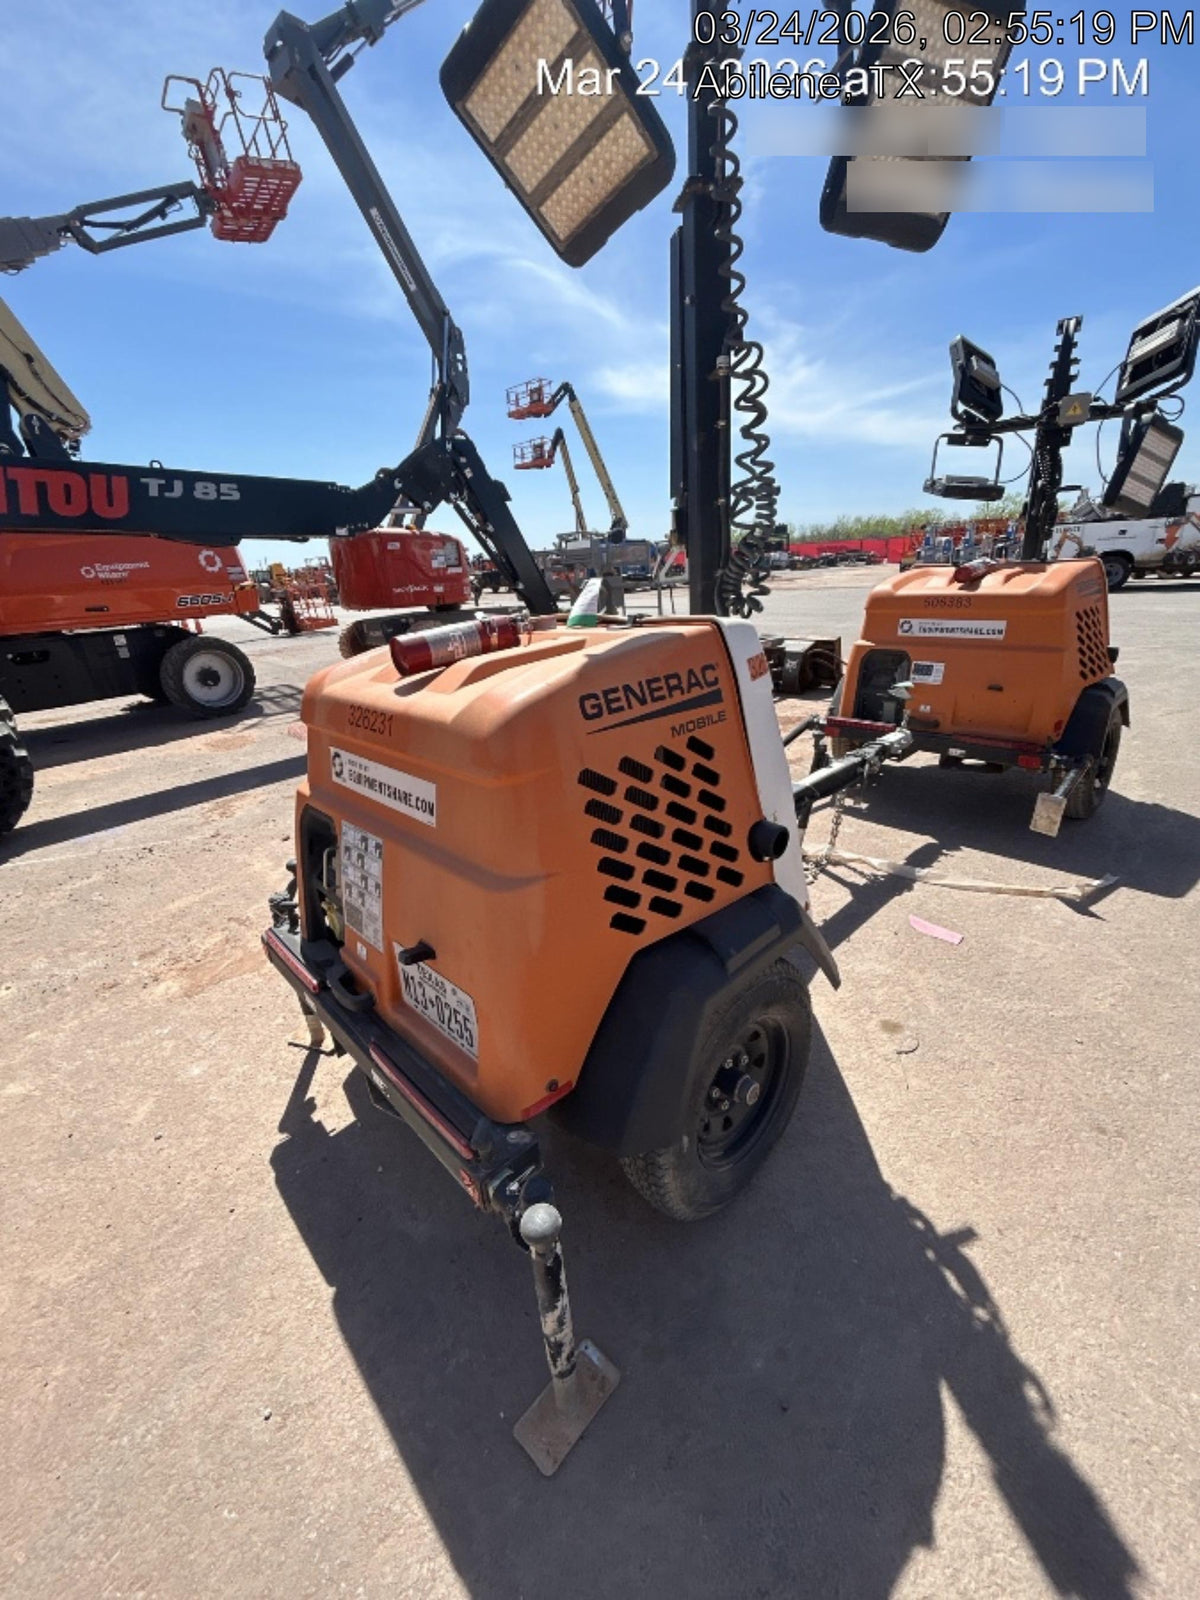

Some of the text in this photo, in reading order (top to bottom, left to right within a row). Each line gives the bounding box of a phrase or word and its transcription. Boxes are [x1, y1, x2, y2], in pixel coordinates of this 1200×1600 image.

[140, 477, 184, 499] TJ
[193, 481, 241, 501] 85
[578, 663, 720, 721] GENERAC
[347, 703, 394, 737] 326231
[670, 710, 727, 738] MOBILE
